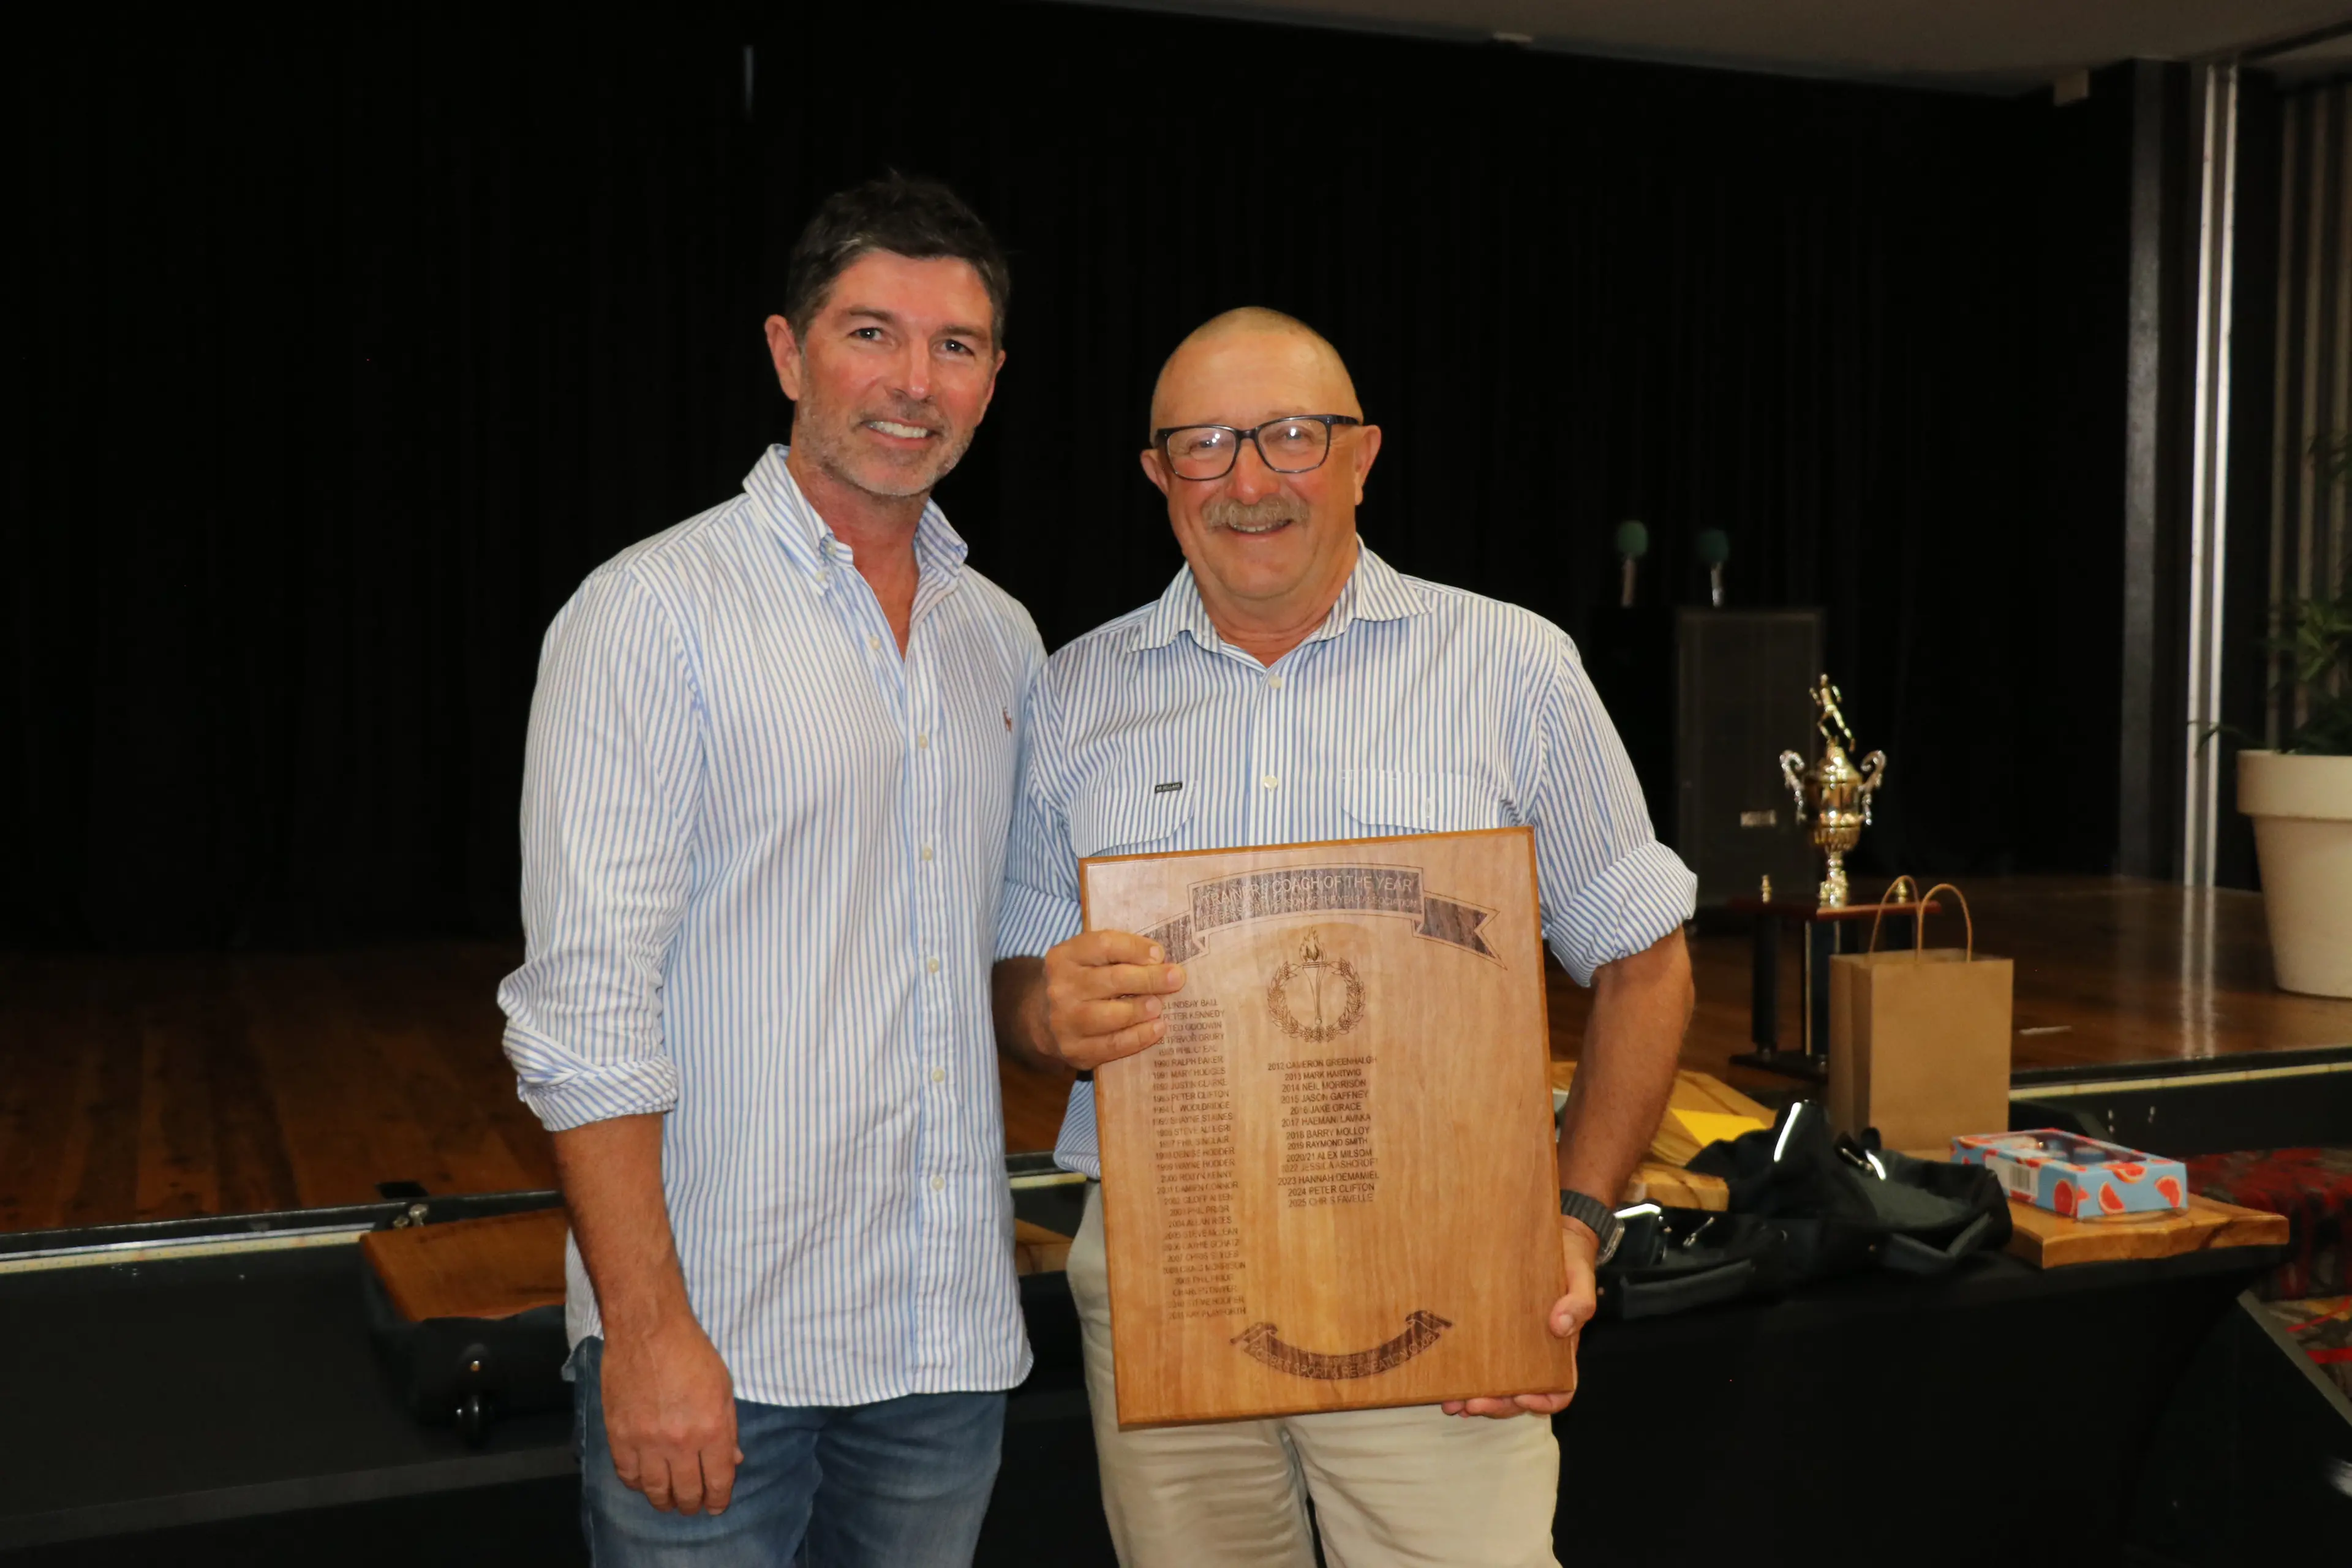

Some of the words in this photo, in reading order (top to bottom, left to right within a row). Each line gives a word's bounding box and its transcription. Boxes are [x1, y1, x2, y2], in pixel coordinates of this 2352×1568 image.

[1272, 876, 1319, 893] COACH
[1324, 875, 1341, 890] OF
[1345, 875, 1372, 889] THE
[1375, 876, 1411, 893] YEAR
[1167, 1000, 1199, 1010] LINDSAY
[1200, 998, 1219, 1007] BALL
[1163, 1012, 1188, 1021] PETER
[1189, 1009, 1226, 1019] KENNEDY
[1185, 1021, 1223, 1031] GOODWIN
[1167, 1035, 1197, 1046] TREVOR
[1199, 1033, 1225, 1041] DRURY
[1171, 1058, 1196, 1067] RALPH
[1268, 1063, 1284, 1071] 2012
[1286, 1060, 1324, 1069] CAMERON
[1171, 1069, 1193, 1079] MARY
[1303, 1071, 1325, 1079] MARK
[1326, 1069, 1362, 1078] HARTWIG
[1171, 1080, 1196, 1090] JUSTIN
[1281, 1084, 1300, 1093] 2014
[1302, 1082, 1320, 1091] NEIL
[1322, 1079, 1366, 1090] MORRISON
[1197, 1090, 1229, 1099] CLIFTON
[1281, 1095, 1300, 1104] 2015
[1302, 1093, 1328, 1103] JASON
[1330, 1090, 1369, 1101] GAFFNEY
[1180, 1101, 1231, 1112] WOOLDRIDGE
[1290, 1106, 1309, 1115] 2016
[1310, 1104, 1331, 1114] JAKE
[1332, 1101, 1362, 1112] GRACE
[1170, 1114, 1200, 1125] SHAYNE
[1202, 1112, 1233, 1122] STAINES
[1281, 1118, 1300, 1128] 2017
[1286, 1130, 1305, 1140] 2018
[1306, 1128, 1334, 1138] BARRY
[1335, 1126, 1370, 1136] MOLLOY
[1195, 1135, 1229, 1145] SINCLAIR
[1287, 1142, 1305, 1151] 2019
[1306, 1139, 1343, 1149] RAYMOND
[1344, 1137, 1368, 1146] SMITH
[1317, 1151, 1338, 1161] ALEX
[1340, 1148, 1373, 1158] MILSOM
[1174, 1160, 1201, 1170] WAYNE
[1203, 1158, 1235, 1168] HODDER
[1278, 1177, 1297, 1186] 2023
[1298, 1174, 1334, 1185] HANNAH
[1335, 1170, 1379, 1182] DEMAMIEL
[1287, 1188, 1306, 1197] 2024
[1308, 1185, 1336, 1195] PETER
[1338, 1182, 1374, 1193] CLIFTON
[1289, 1199, 1307, 1208] 2025
[1337, 1193, 1374, 1204] FAVELLE
